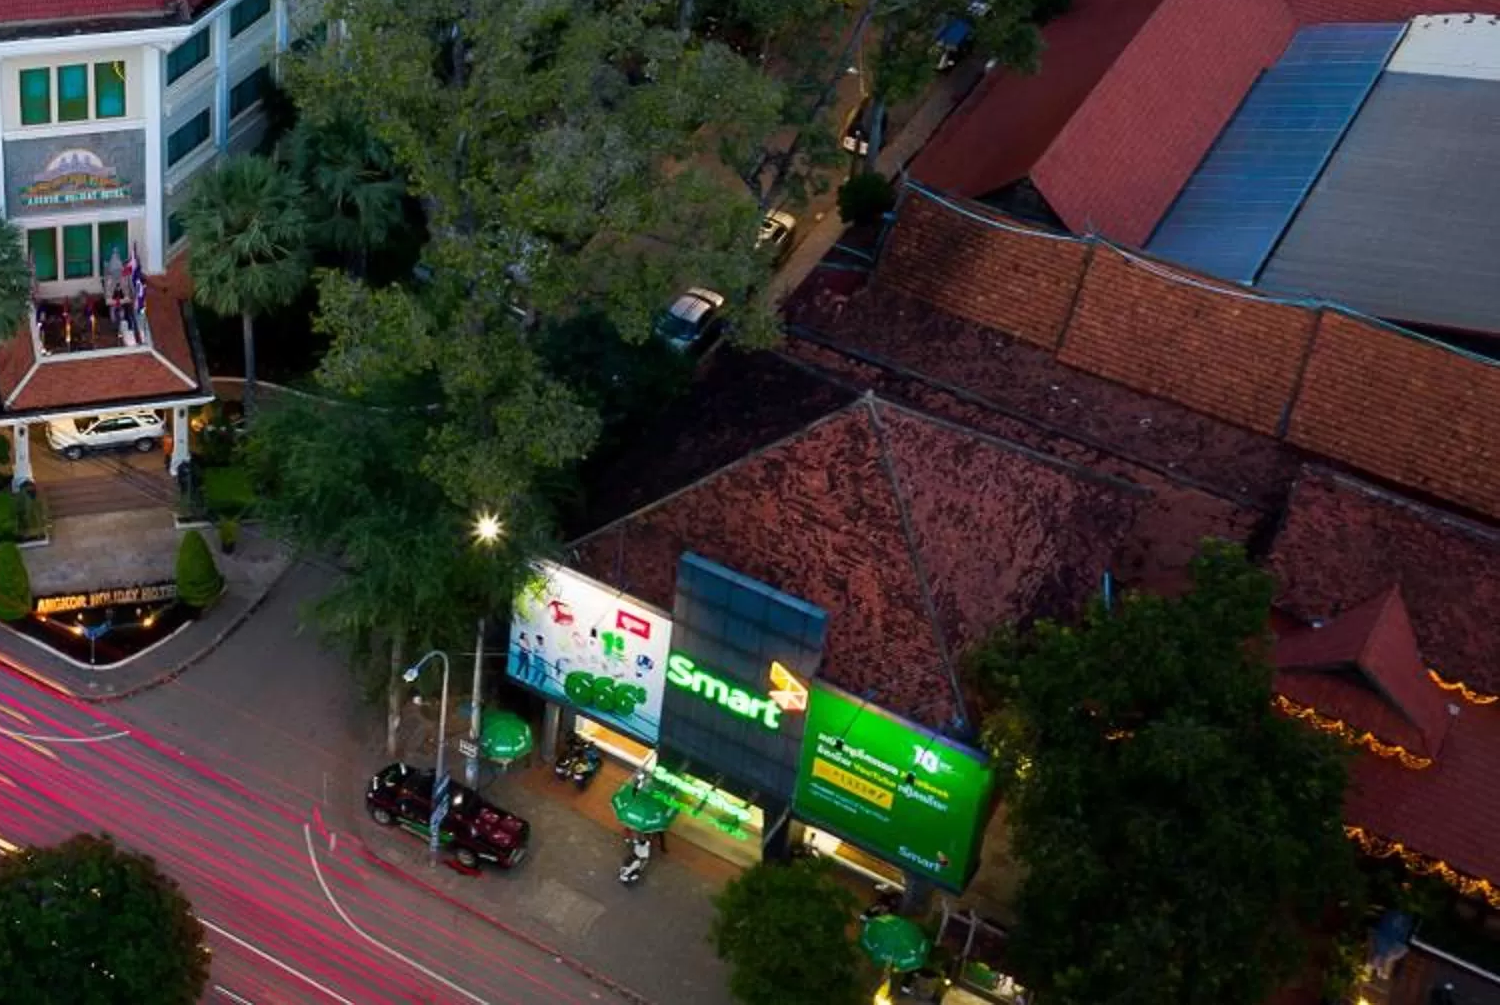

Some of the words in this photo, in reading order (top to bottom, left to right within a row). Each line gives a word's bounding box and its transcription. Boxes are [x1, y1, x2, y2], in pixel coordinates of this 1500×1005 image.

[37, 595, 86, 614] ANGKOR
[90, 589, 140, 607] HOLIDAY
[667, 654, 782, 729] Smart
[913, 744, 939, 774] 10
[898, 845, 941, 873] Smart
